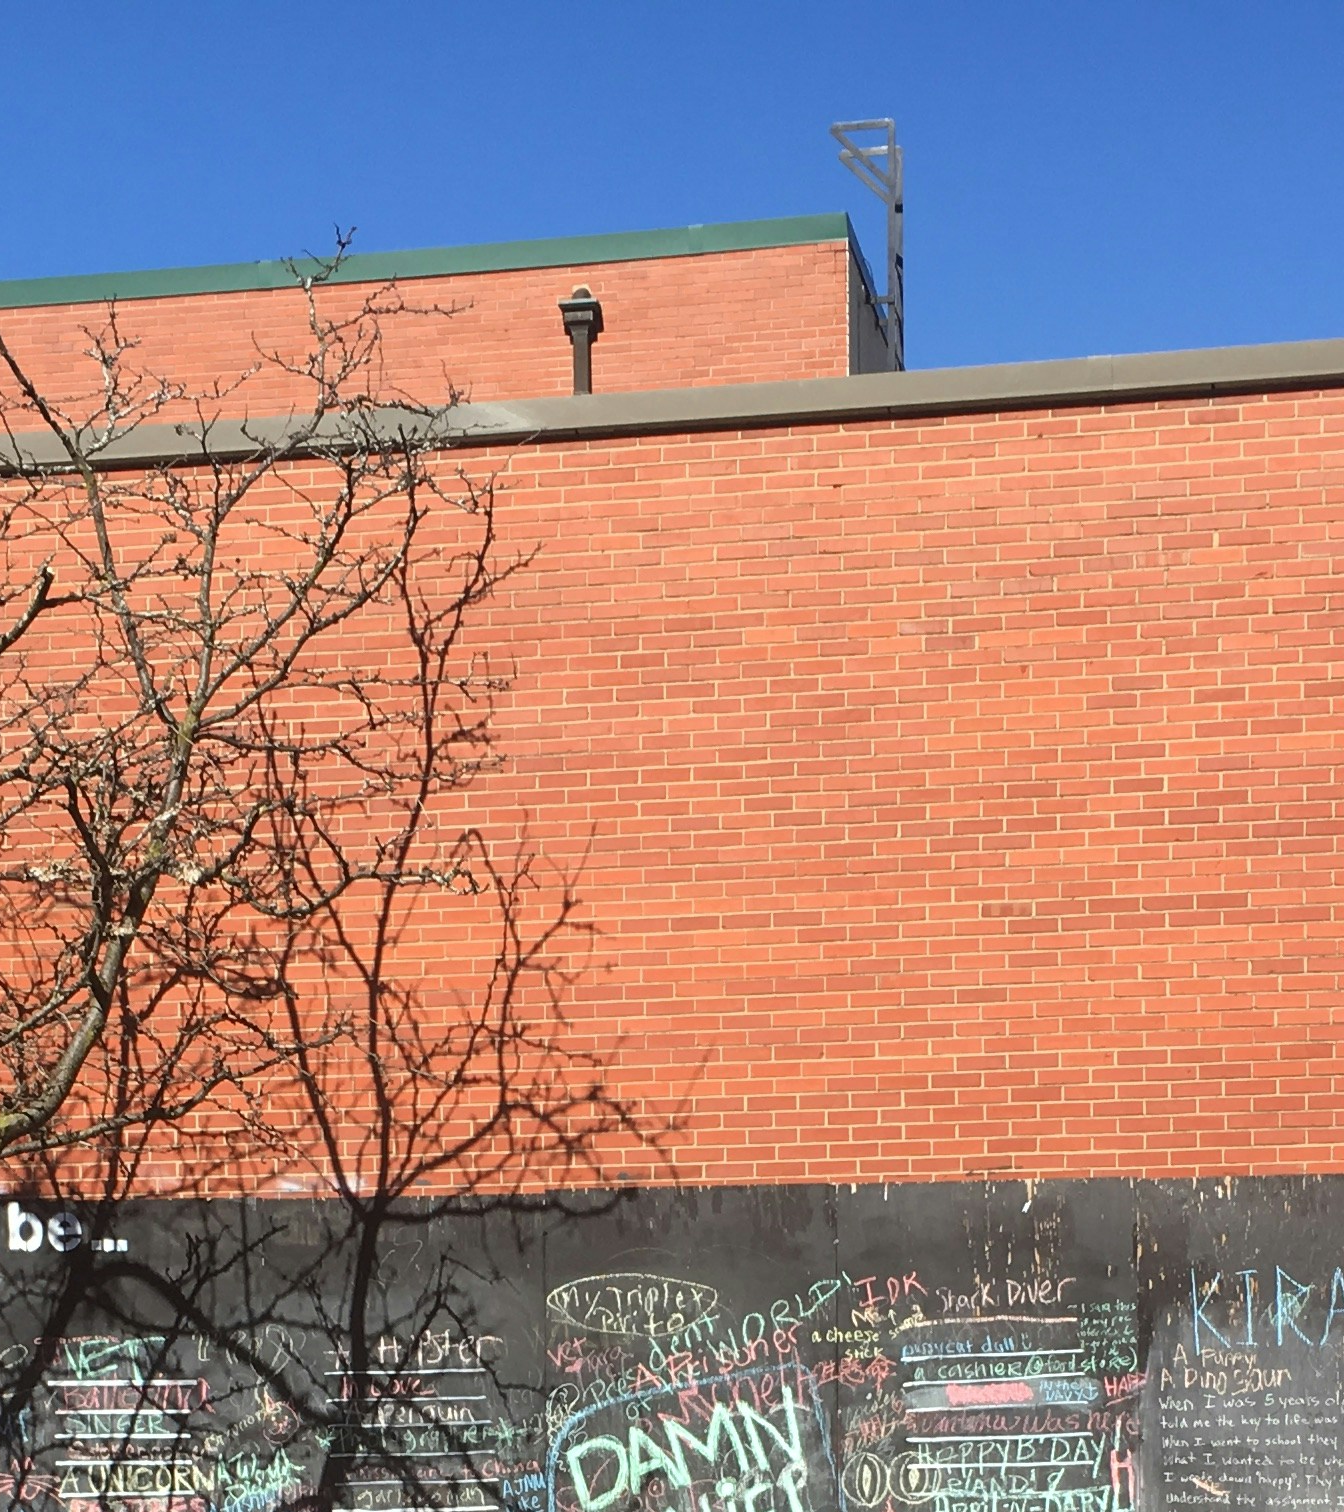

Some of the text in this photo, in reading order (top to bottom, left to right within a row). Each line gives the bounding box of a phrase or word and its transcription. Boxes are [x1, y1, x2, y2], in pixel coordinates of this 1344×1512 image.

[7, 1201, 129, 1252] be...
[853, 1270, 929, 1307] IDK
[825, 1326, 880, 1343] cheese
[1172, 1342, 1189, 1363] A
[1159, 1367, 1176, 1392] A
[1204, 1395, 1216, 1409] I
[1223, 1399, 1256, 1409] was
[1264, 1394, 1275, 1407] 5
[1279, 1396, 1320, 1410] years
[1160, 1414, 1189, 1430] told
[1193, 1419, 1211, 1428] me
[1216, 1415, 1236, 1428] the
[1240, 1413, 1262, 1432] key
[1264, 1415, 1281, 1426] to
[1284, 1412, 1308, 1427] life
[1313, 1416, 1339, 1426] was
[566, 1384, 805, 1511] DAMN
[1194, 1436, 1206, 1448] I
[1210, 1437, 1242, 1448] went
[1246, 1437, 1260, 1447] to
[1264, 1434, 1302, 1446] school
[1307, 1432, 1339, 1451] they
[1204, 1453, 1215, 1466] I
[1221, 1453, 1275, 1467] wanted
[1279, 1454, 1295, 1467] to
[1164, 1471, 1175, 1483] I
[1218, 1470, 1254, 1484] down
[1237, 1493, 1257, 1506] the
